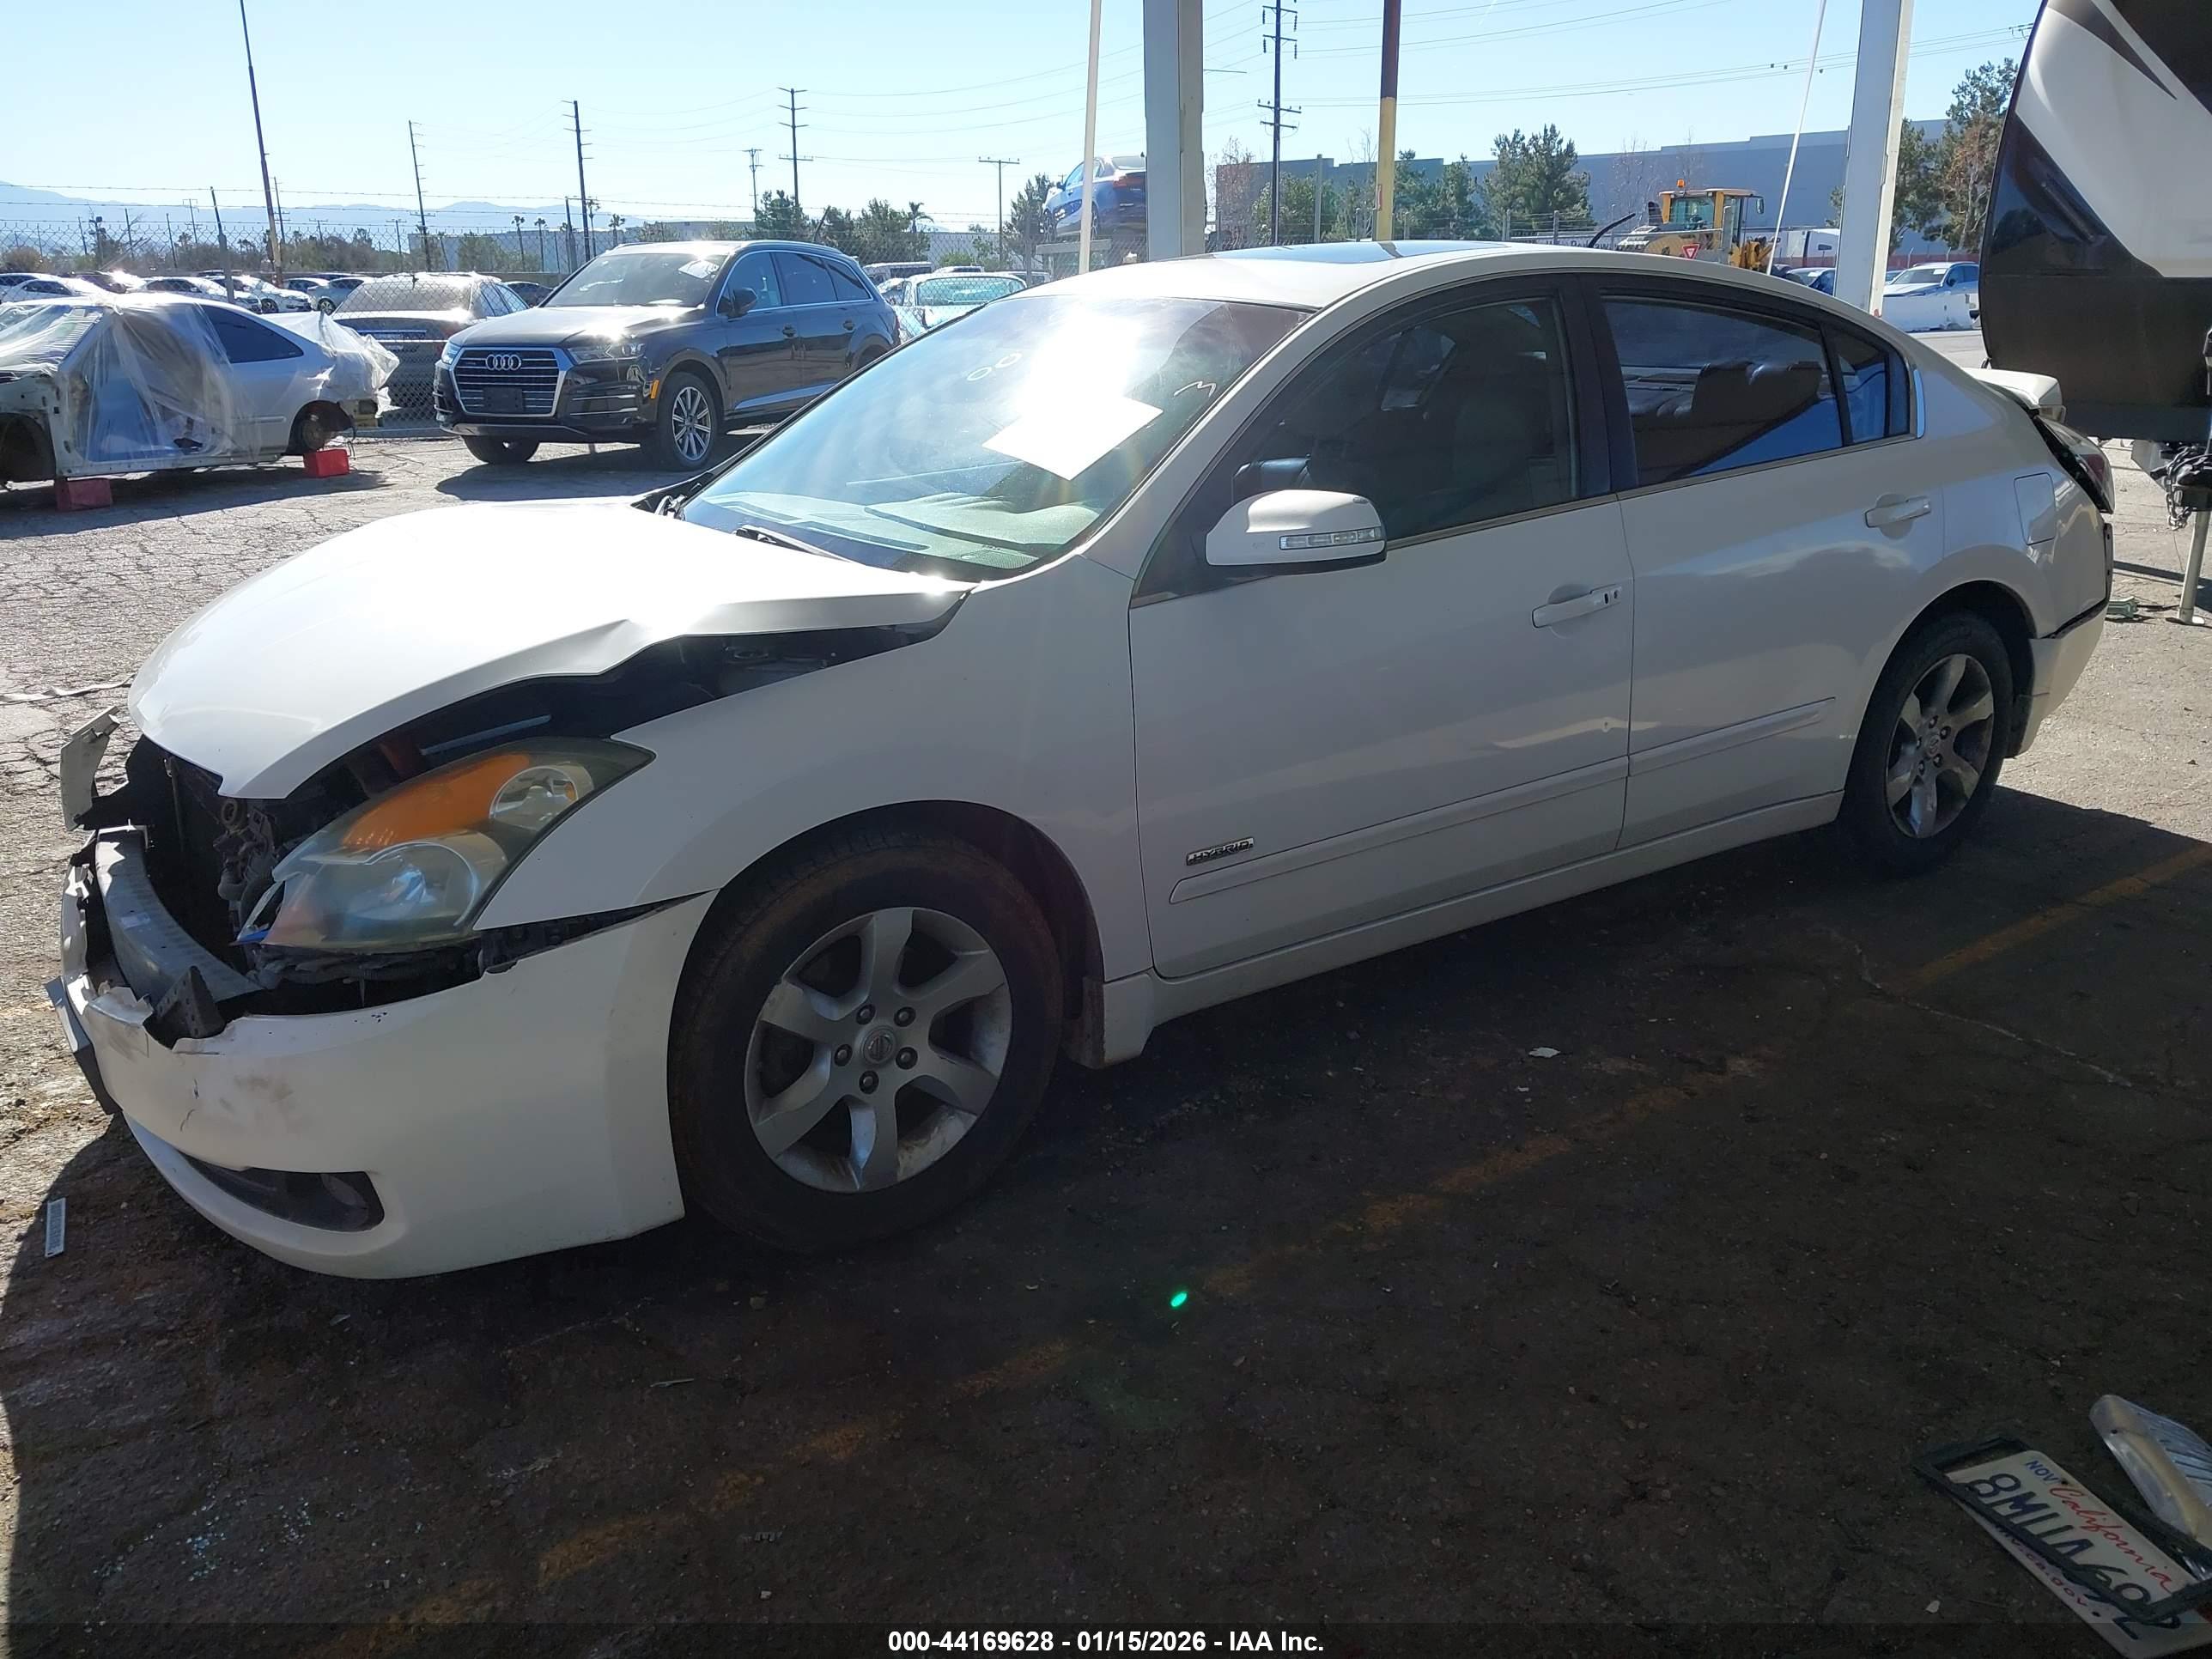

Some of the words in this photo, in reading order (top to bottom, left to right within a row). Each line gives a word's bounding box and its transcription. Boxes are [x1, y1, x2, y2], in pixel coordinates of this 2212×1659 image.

[1191, 839, 1251, 862] HYBRID
[2025, 1461, 2059, 1483] NOV
[2049, 1487, 2172, 1594] California
